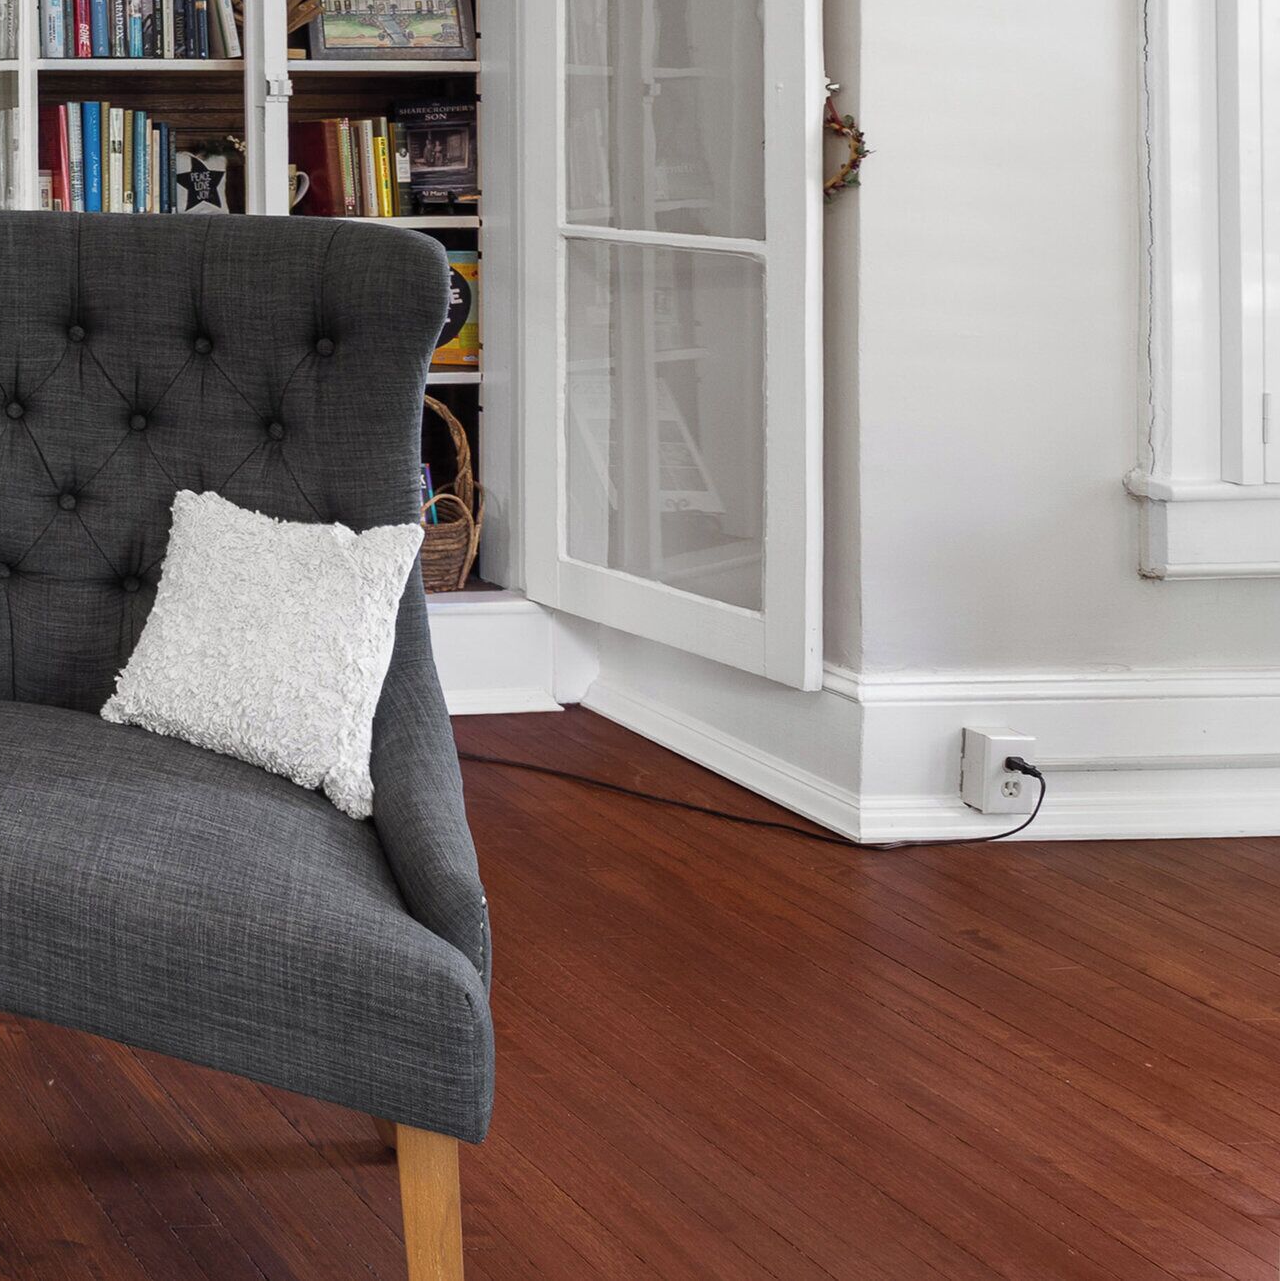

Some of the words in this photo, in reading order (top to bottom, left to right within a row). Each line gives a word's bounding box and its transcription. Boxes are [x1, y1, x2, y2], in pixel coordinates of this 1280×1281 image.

[80, 23, 90, 45] GONE
[175, 15, 185, 44] AFFINITY
[399, 105, 475, 115] SHARECROPPER'S
[425, 113, 448, 121] SON
[190, 171, 212, 182] PEACE
[193, 180, 211, 191] LOVE
[196, 190, 210, 200] JOY
